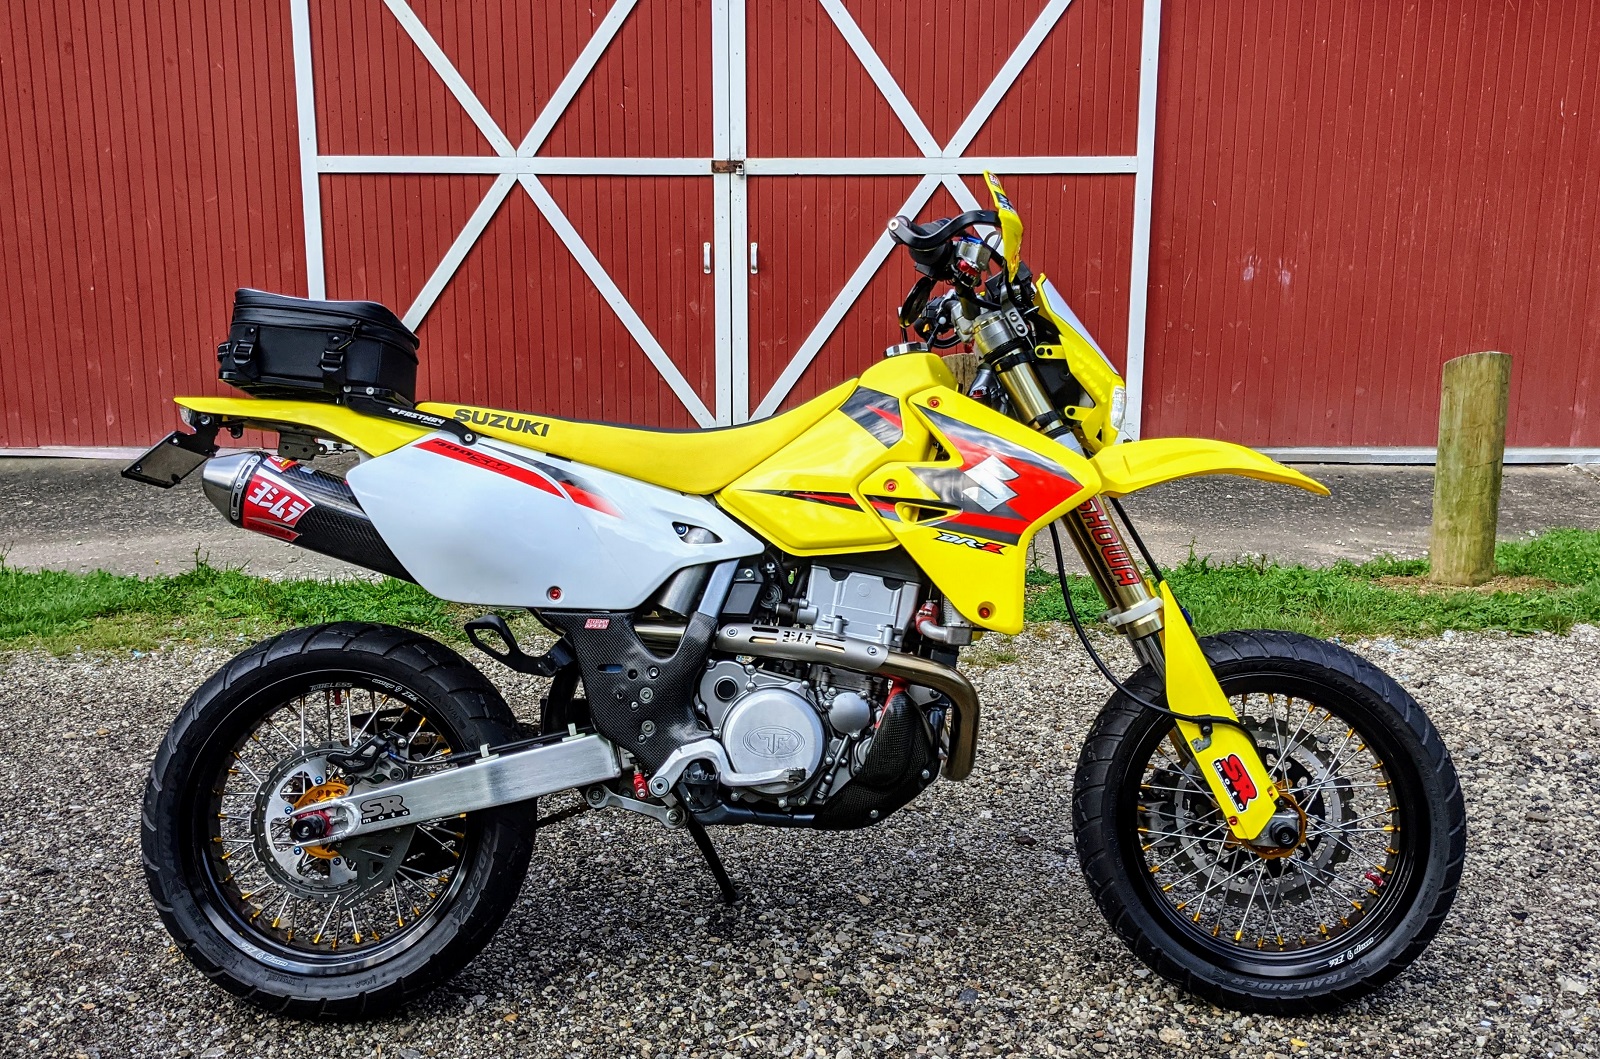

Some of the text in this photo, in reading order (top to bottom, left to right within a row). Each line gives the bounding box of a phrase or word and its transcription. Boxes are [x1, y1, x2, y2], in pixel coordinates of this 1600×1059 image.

[453, 408, 550, 438] SUZUKI
[247, 481, 306, 523] ヨシムラ
[934, 530, 1006, 555] DR-Z
[1214, 761, 1245, 811] moto
[1220, 753, 1258, 807] SR
[360, 794, 408, 819] SR
[361, 809, 410, 824] moto
[1230, 973, 1349, 993] TRAILRIDER
